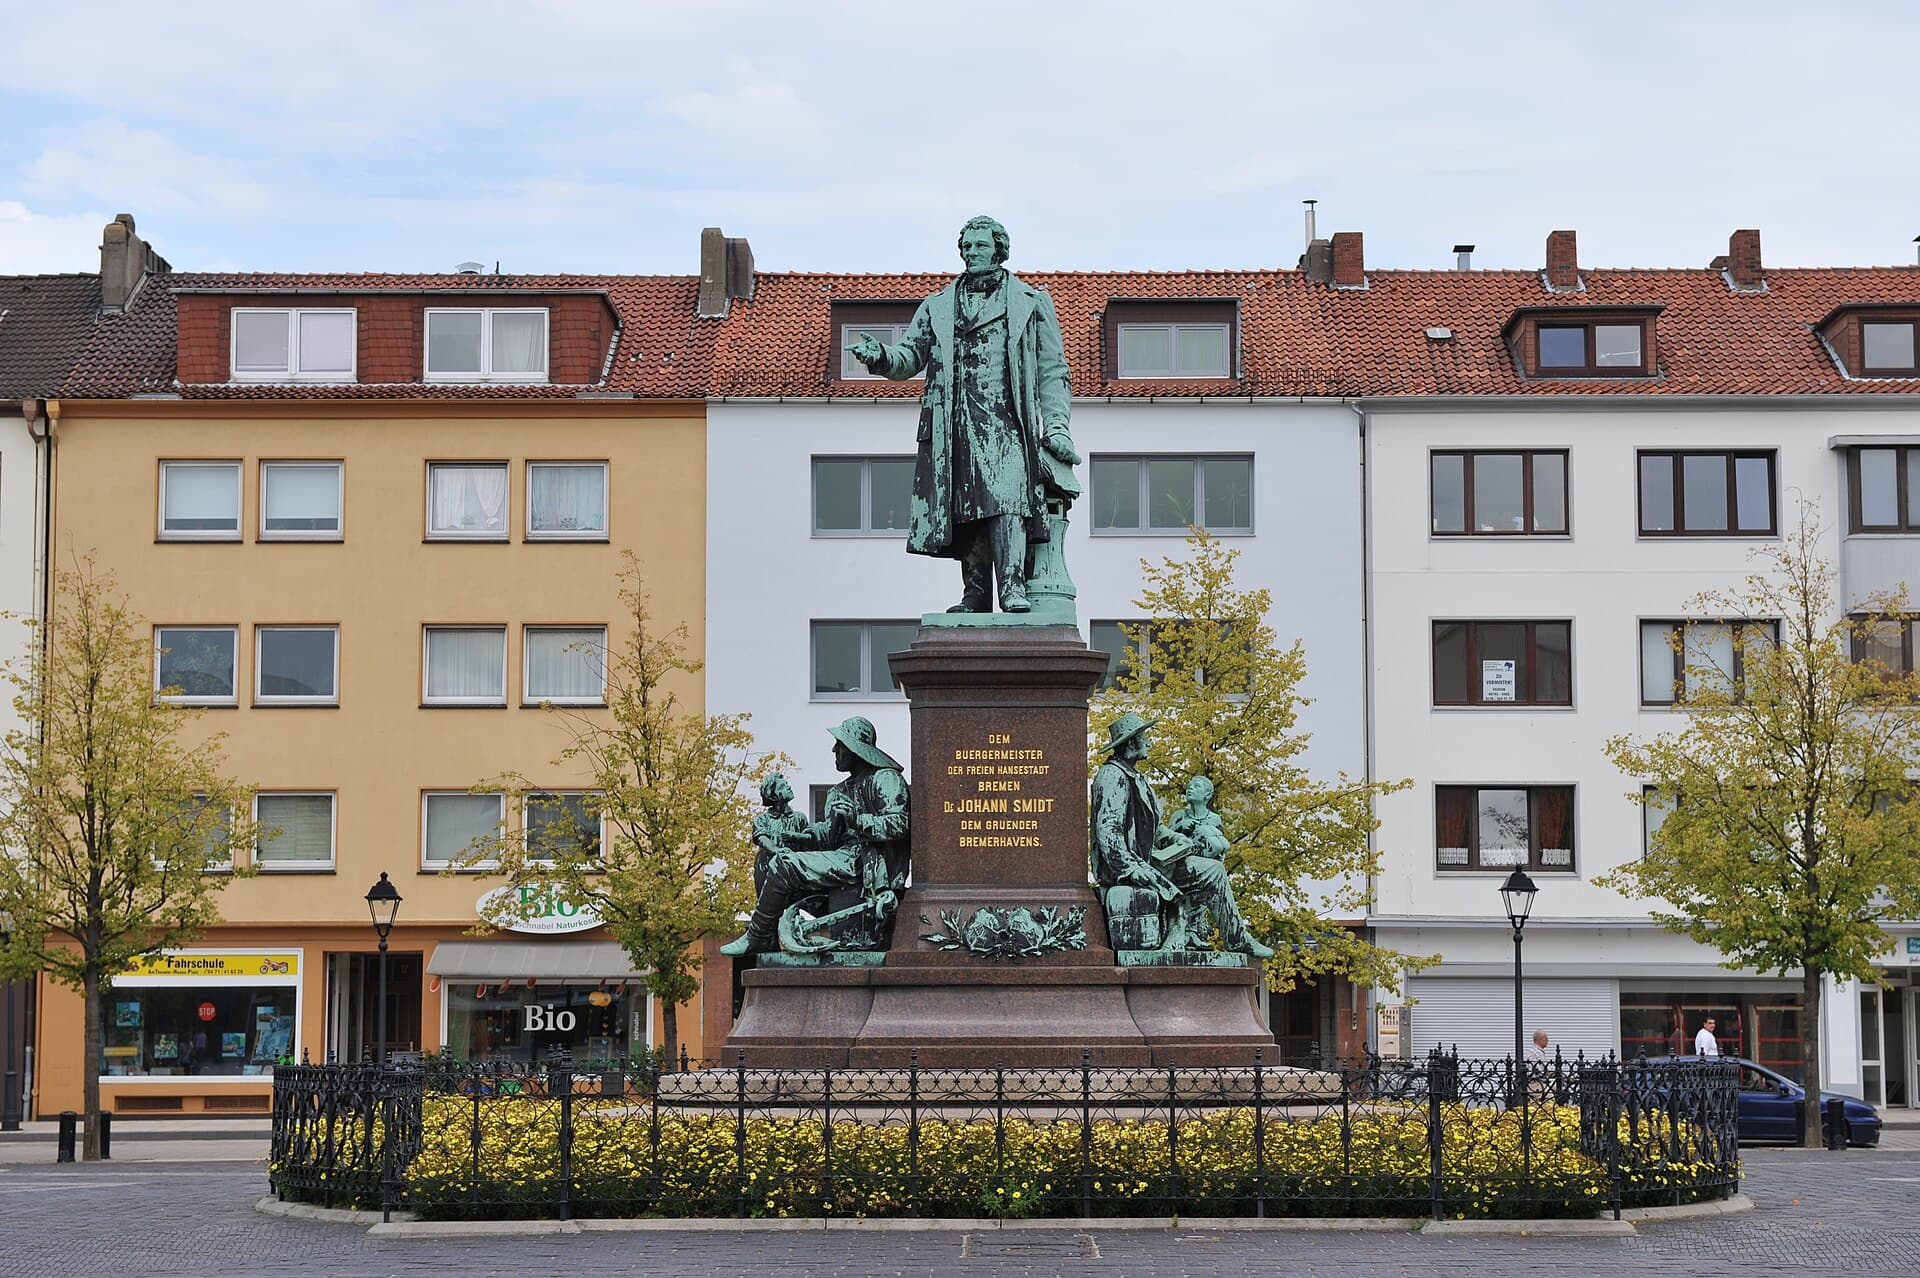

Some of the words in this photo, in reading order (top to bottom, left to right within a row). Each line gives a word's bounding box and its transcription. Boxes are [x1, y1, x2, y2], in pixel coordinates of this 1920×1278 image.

[988, 734, 1010, 744] DEM
[955, 749, 1043, 760] BUERGERMEISTER
[947, 766, 964, 775] DER
[966, 766, 995, 775] FREIEN
[997, 765, 1050, 775] HANSESTADT
[978, 781, 1021, 791] BREMEN
[957, 799, 1008, 813] JOHANN
[1013, 799, 1054, 813] SMIDT
[961, 820, 982, 830] DEM
[985, 820, 1038, 830] GRUENDER
[959, 836, 1043, 847] BREMERHAVENS.
[518, 885, 580, 917] Bio
[167, 955, 225, 969] Fahrschule
[199, 1007, 216, 1016] STOP
[523, 1003, 576, 1031] Bio
